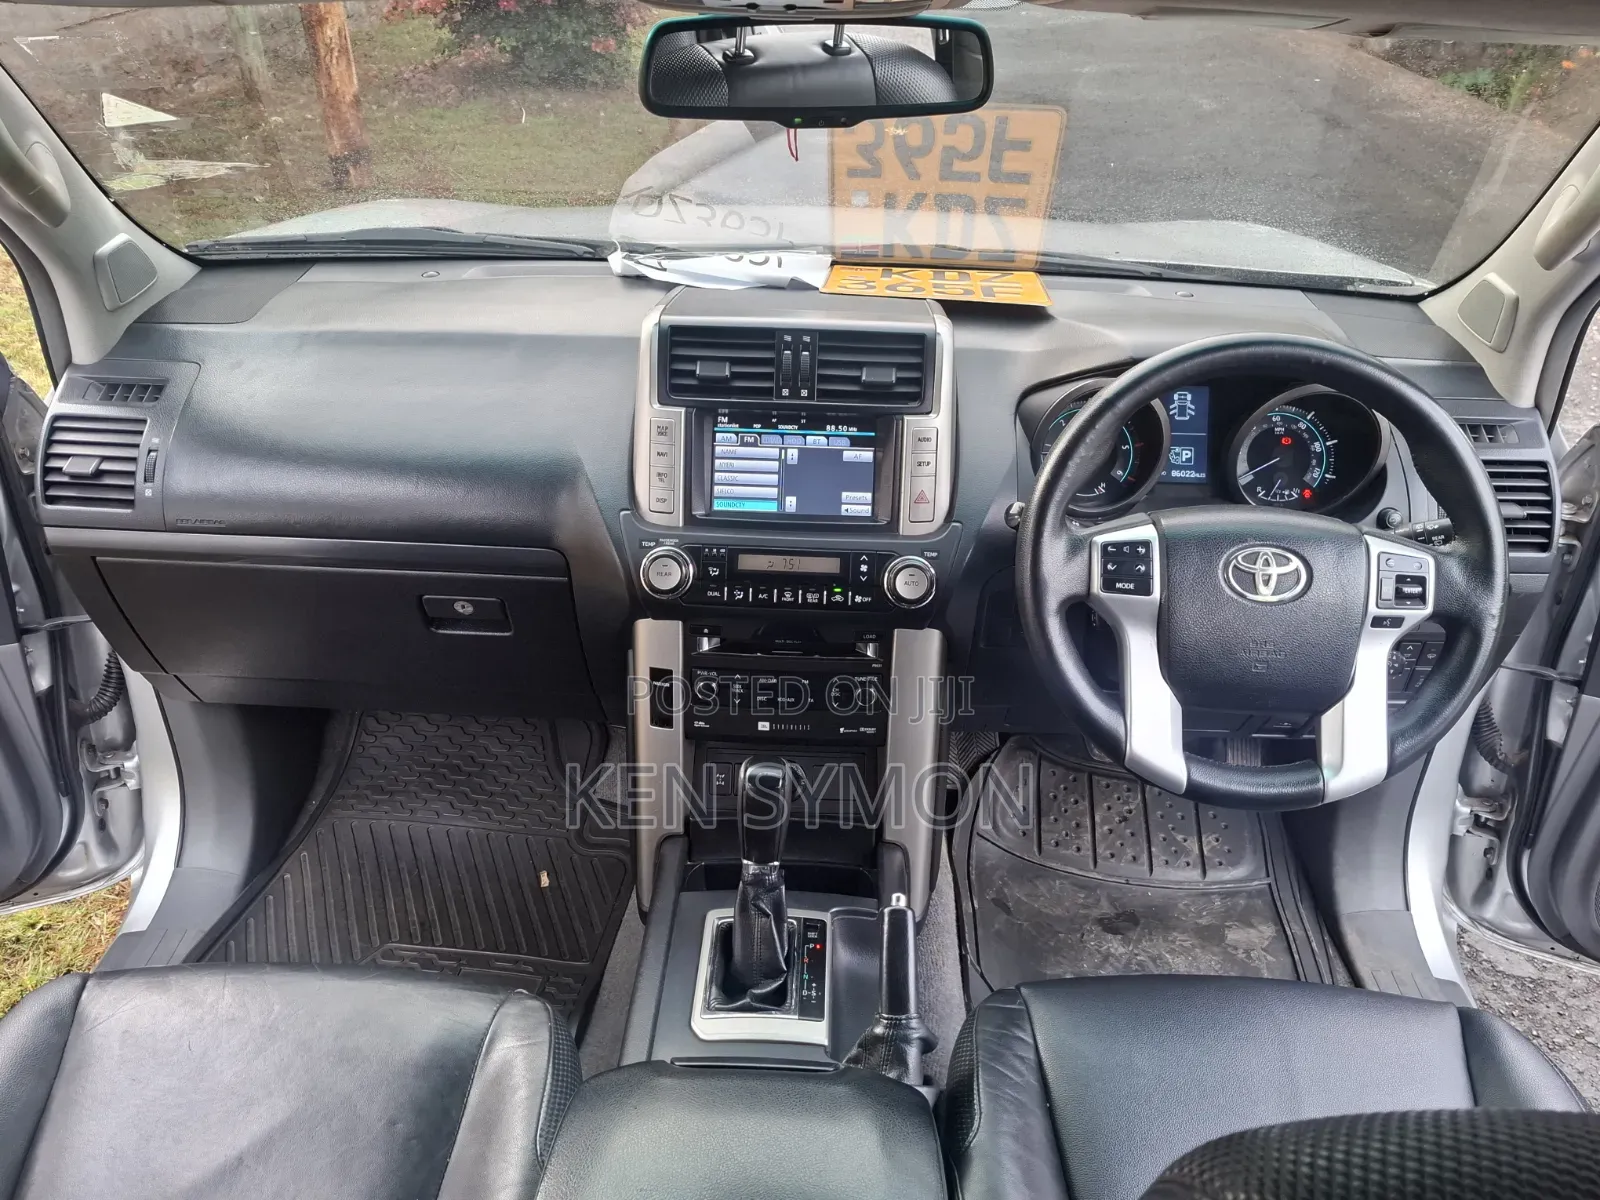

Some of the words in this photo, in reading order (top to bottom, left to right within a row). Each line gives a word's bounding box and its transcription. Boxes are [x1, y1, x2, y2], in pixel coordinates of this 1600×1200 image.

[880, 268, 1014, 283] KDZ
[838, 278, 1023, 298] 365F
[1297, 422, 1306, 430] 80
[1313, 441, 1321, 452] 100
